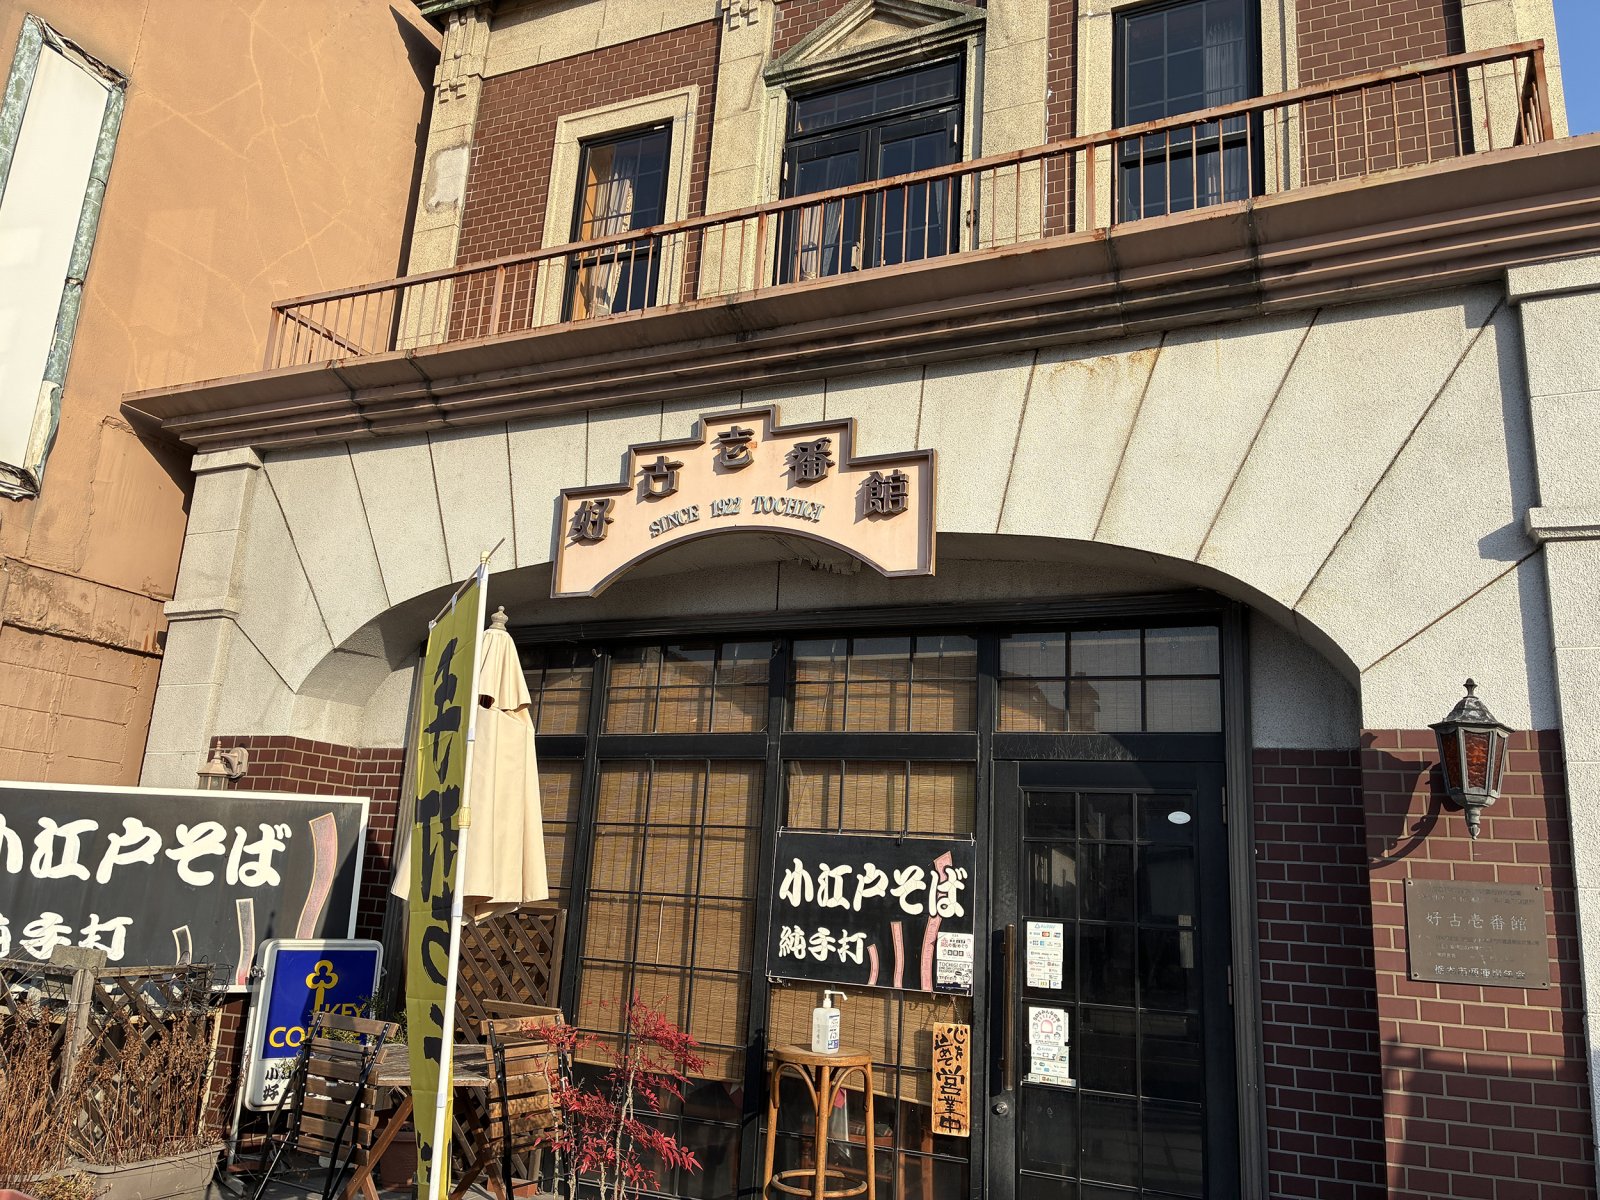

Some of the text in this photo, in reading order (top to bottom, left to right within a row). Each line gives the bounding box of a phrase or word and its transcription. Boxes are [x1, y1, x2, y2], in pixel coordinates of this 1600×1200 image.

[649, 496, 825, 538] SINCE 1922 TOCHIGI
[778, 857, 968, 918] 小江戸そば
[0, 911, 133, 961] 手打
[778, 924, 868, 965] 純手打
[934, 1064, 966, 1134] 営業中
